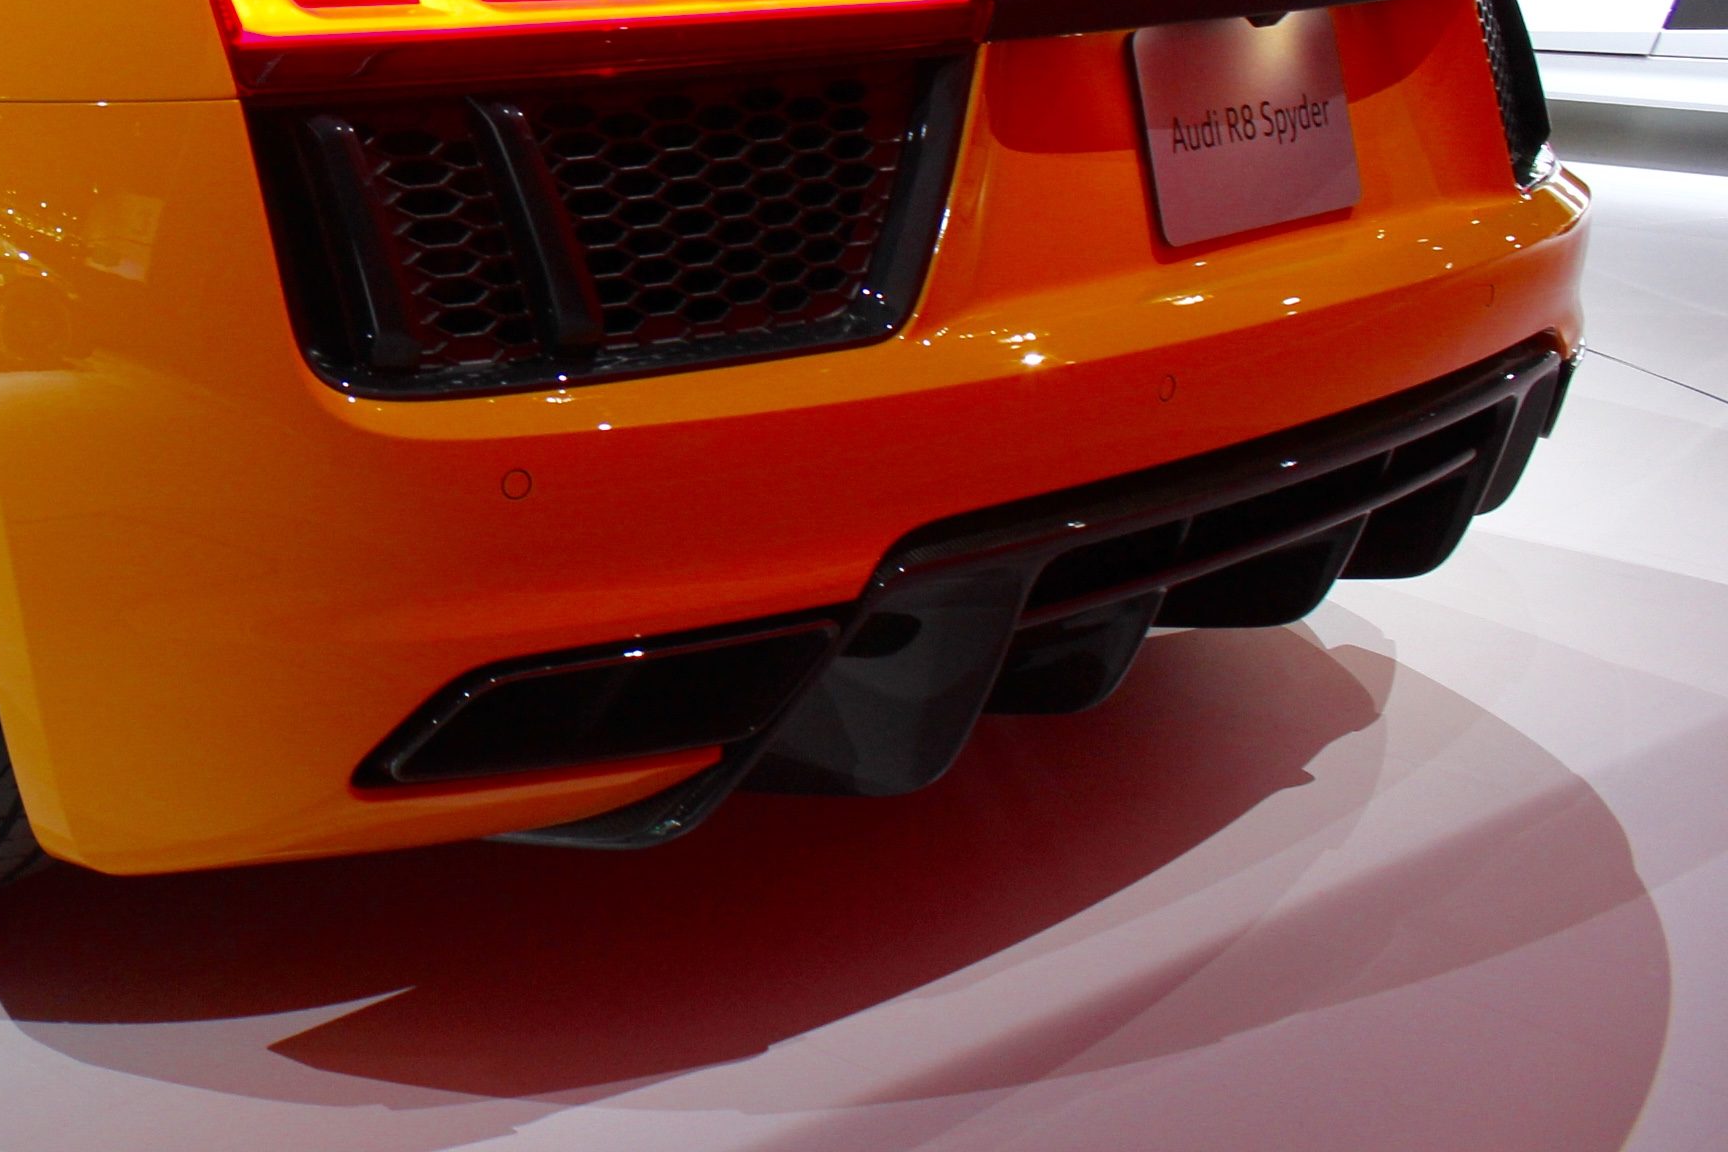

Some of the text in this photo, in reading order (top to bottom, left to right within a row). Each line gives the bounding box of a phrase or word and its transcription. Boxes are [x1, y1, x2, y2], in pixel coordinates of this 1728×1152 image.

[1172, 93, 1330, 154] Audi R8 Spyder
